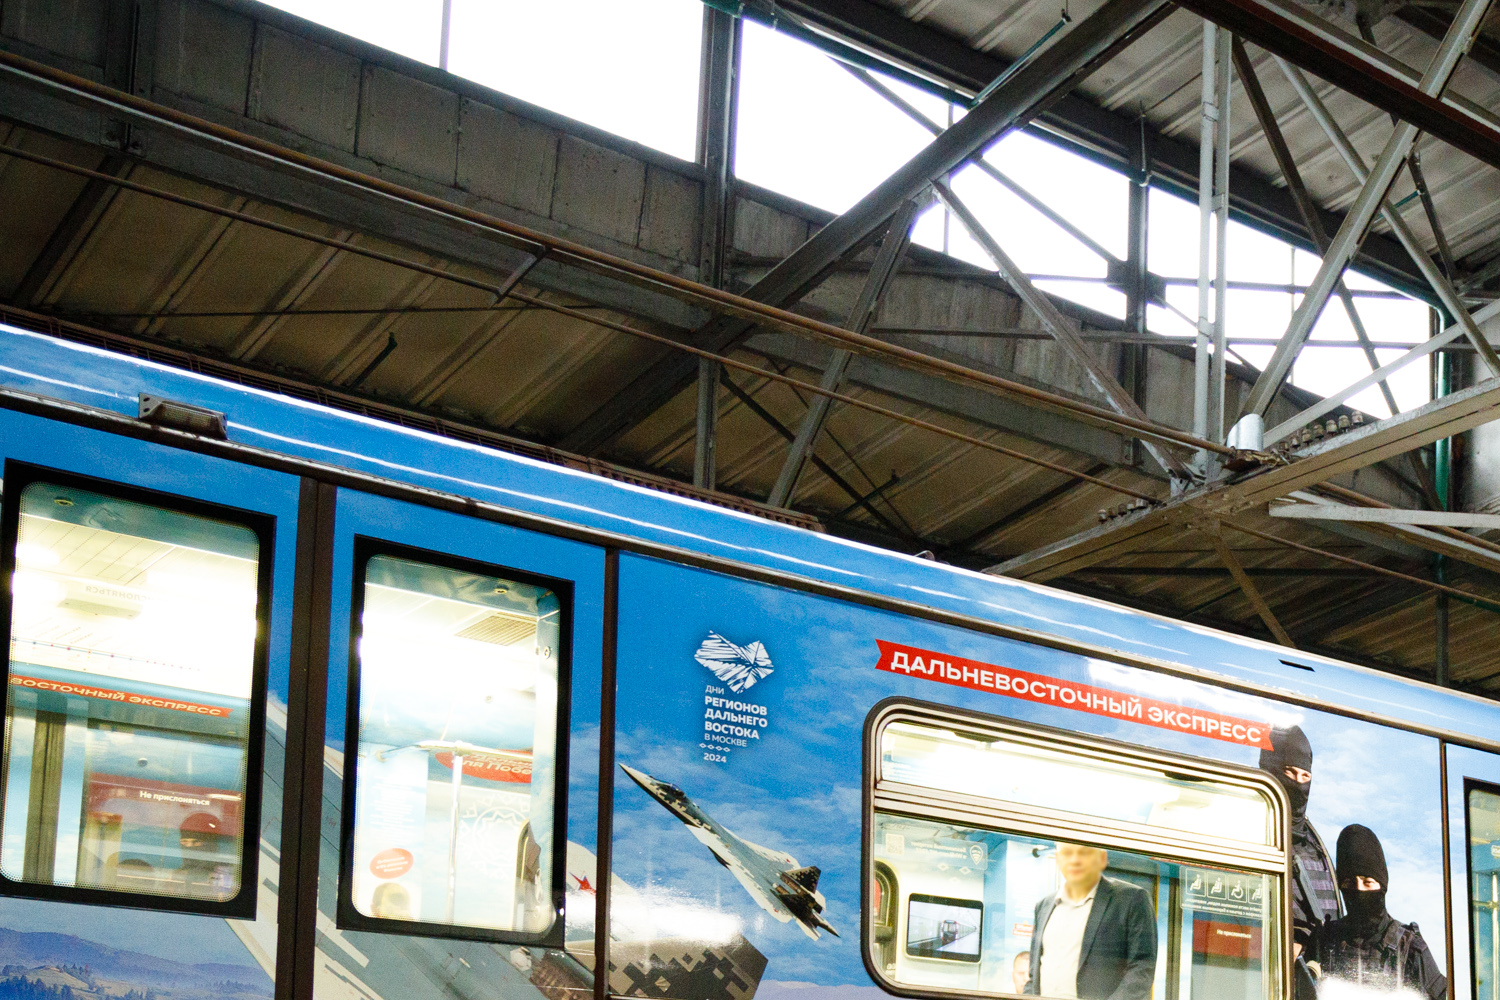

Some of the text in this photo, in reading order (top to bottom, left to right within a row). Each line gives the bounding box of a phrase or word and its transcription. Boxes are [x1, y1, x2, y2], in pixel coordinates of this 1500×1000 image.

[705, 684, 725, 695] ДНИ
[890, 650, 1263, 744] ДАЛЬНЕВОСТОЧНЫЙ ЭКСПРЕСС
[128, 695, 222, 716] ЭКСПРЕСС
[704, 695, 768, 716] РЕГИОНОВ
[704, 708, 769, 728] ДАЛЬНЕГО
[704, 720, 760, 740] ВОСТОКА
[704, 733, 748, 748] В МОСКВЕ
[703, 752, 727, 763] 2024
[139, 790, 211, 807] Не прислоняться
